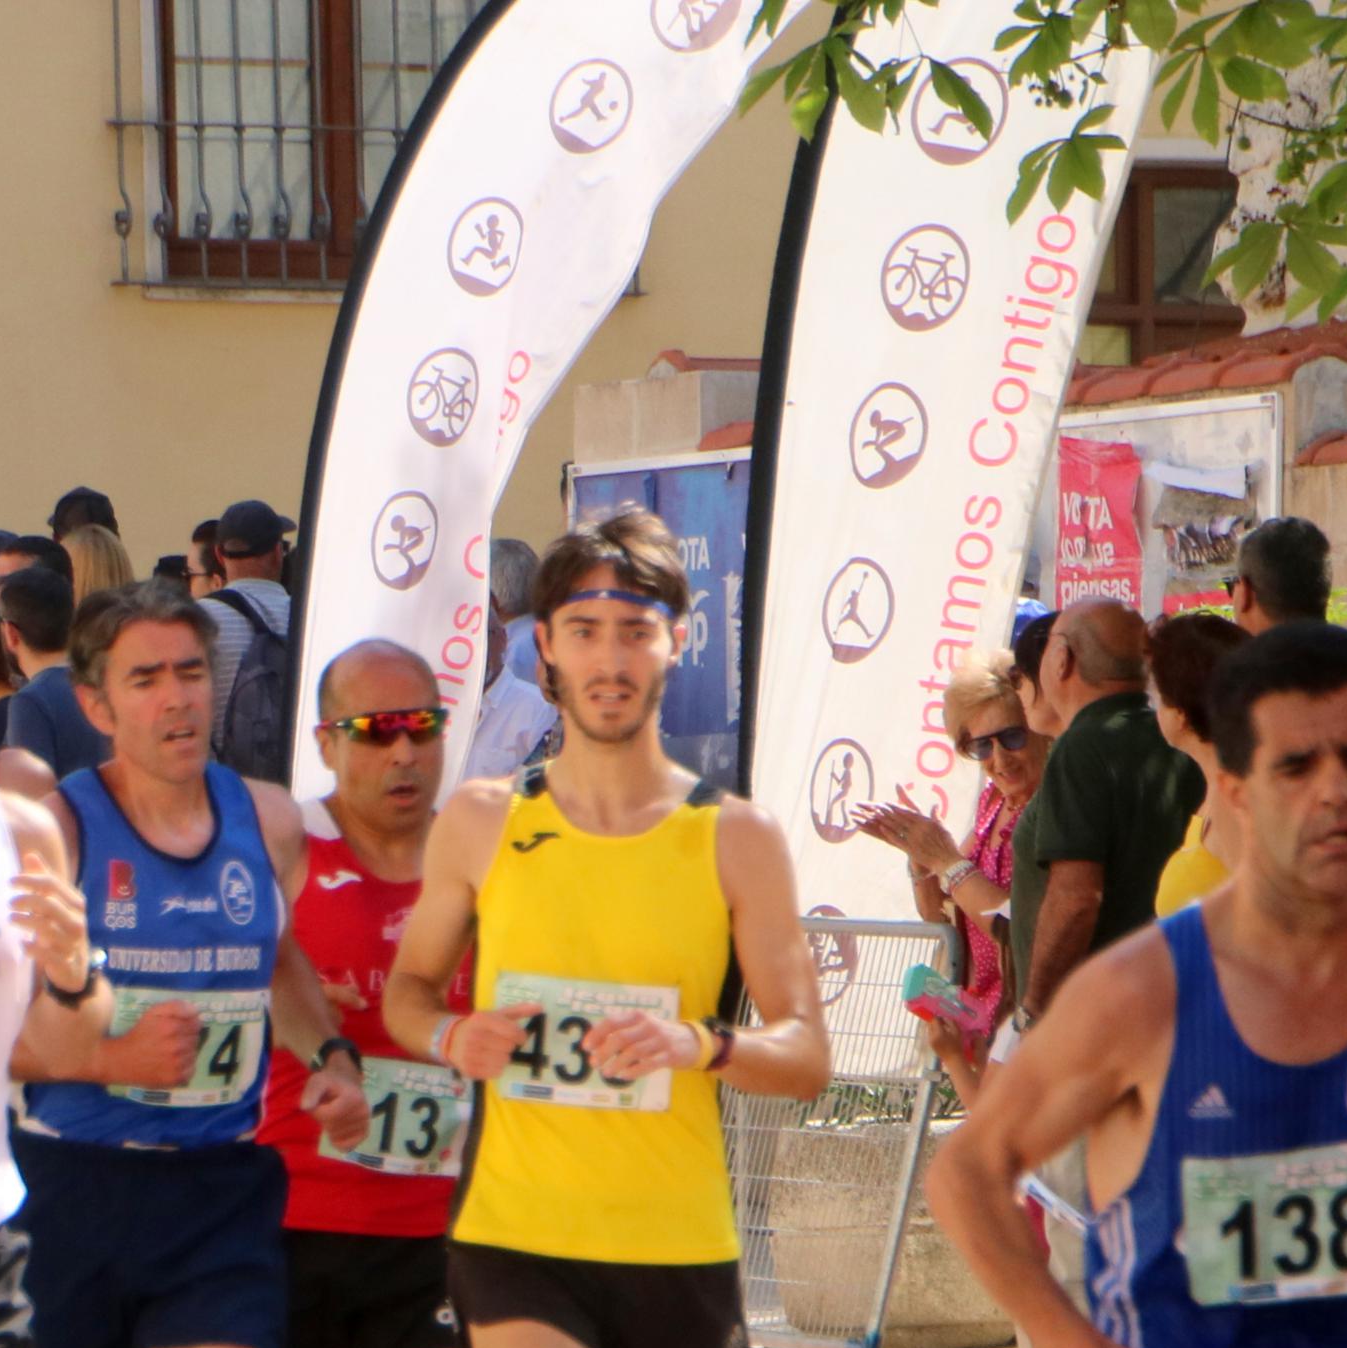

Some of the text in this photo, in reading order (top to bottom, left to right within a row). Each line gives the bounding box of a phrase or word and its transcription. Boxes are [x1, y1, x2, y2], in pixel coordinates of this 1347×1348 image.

[969, 213, 1079, 467] Contigo
[677, 536, 710, 571] OTA
[194, 949, 213, 973] DE
[510, 1012, 638, 1089] 43
[372, 1092, 441, 1158] 13
